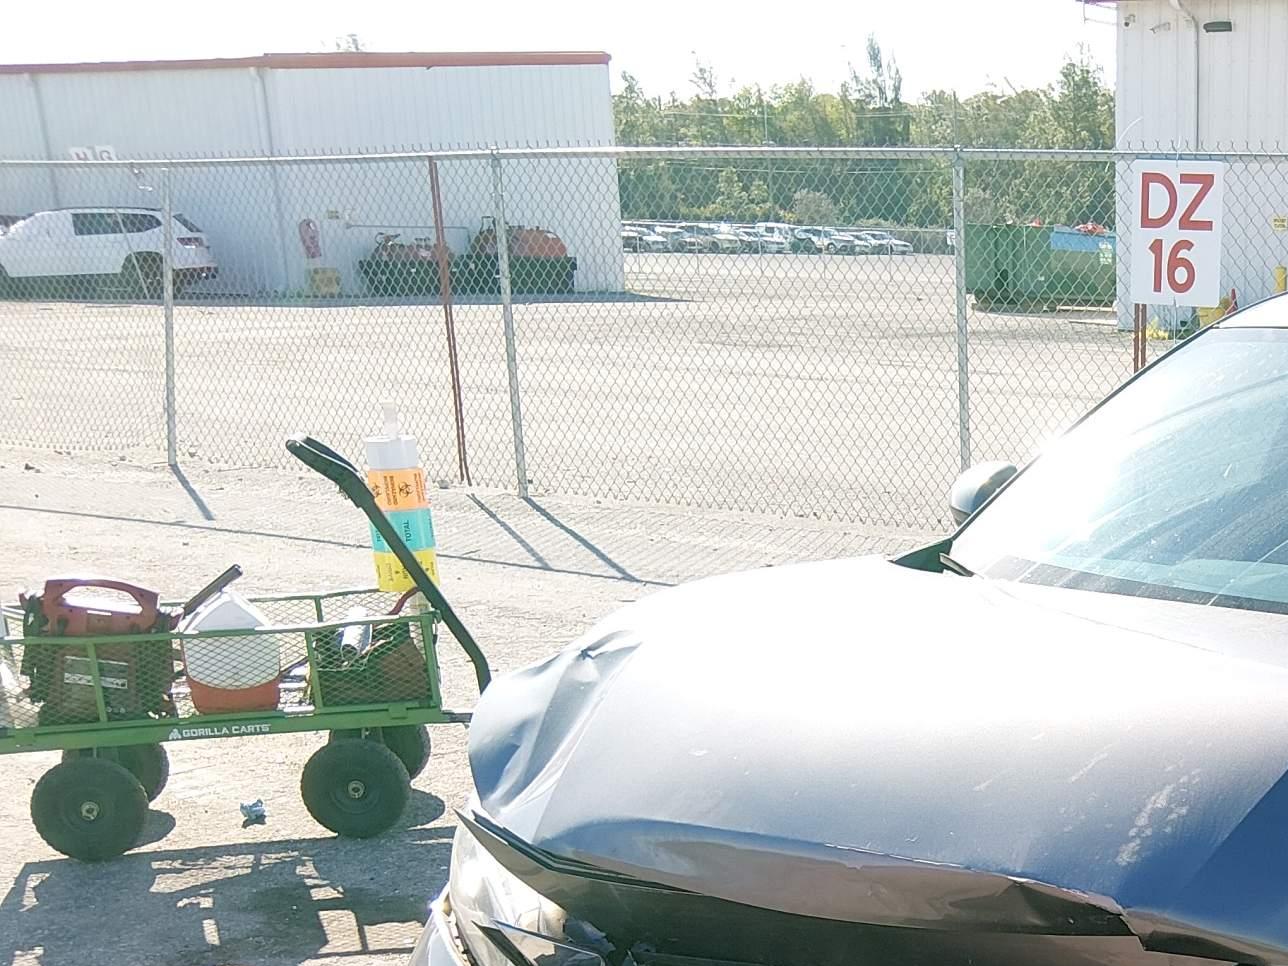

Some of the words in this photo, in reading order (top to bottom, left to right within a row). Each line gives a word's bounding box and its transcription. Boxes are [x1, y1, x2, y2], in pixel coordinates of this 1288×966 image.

[1140, 172, 1215, 231] DZ
[1149, 238, 1196, 293] 16
[182, 726, 230, 738] GORILLA
[231, 723, 270, 735] CARTS
